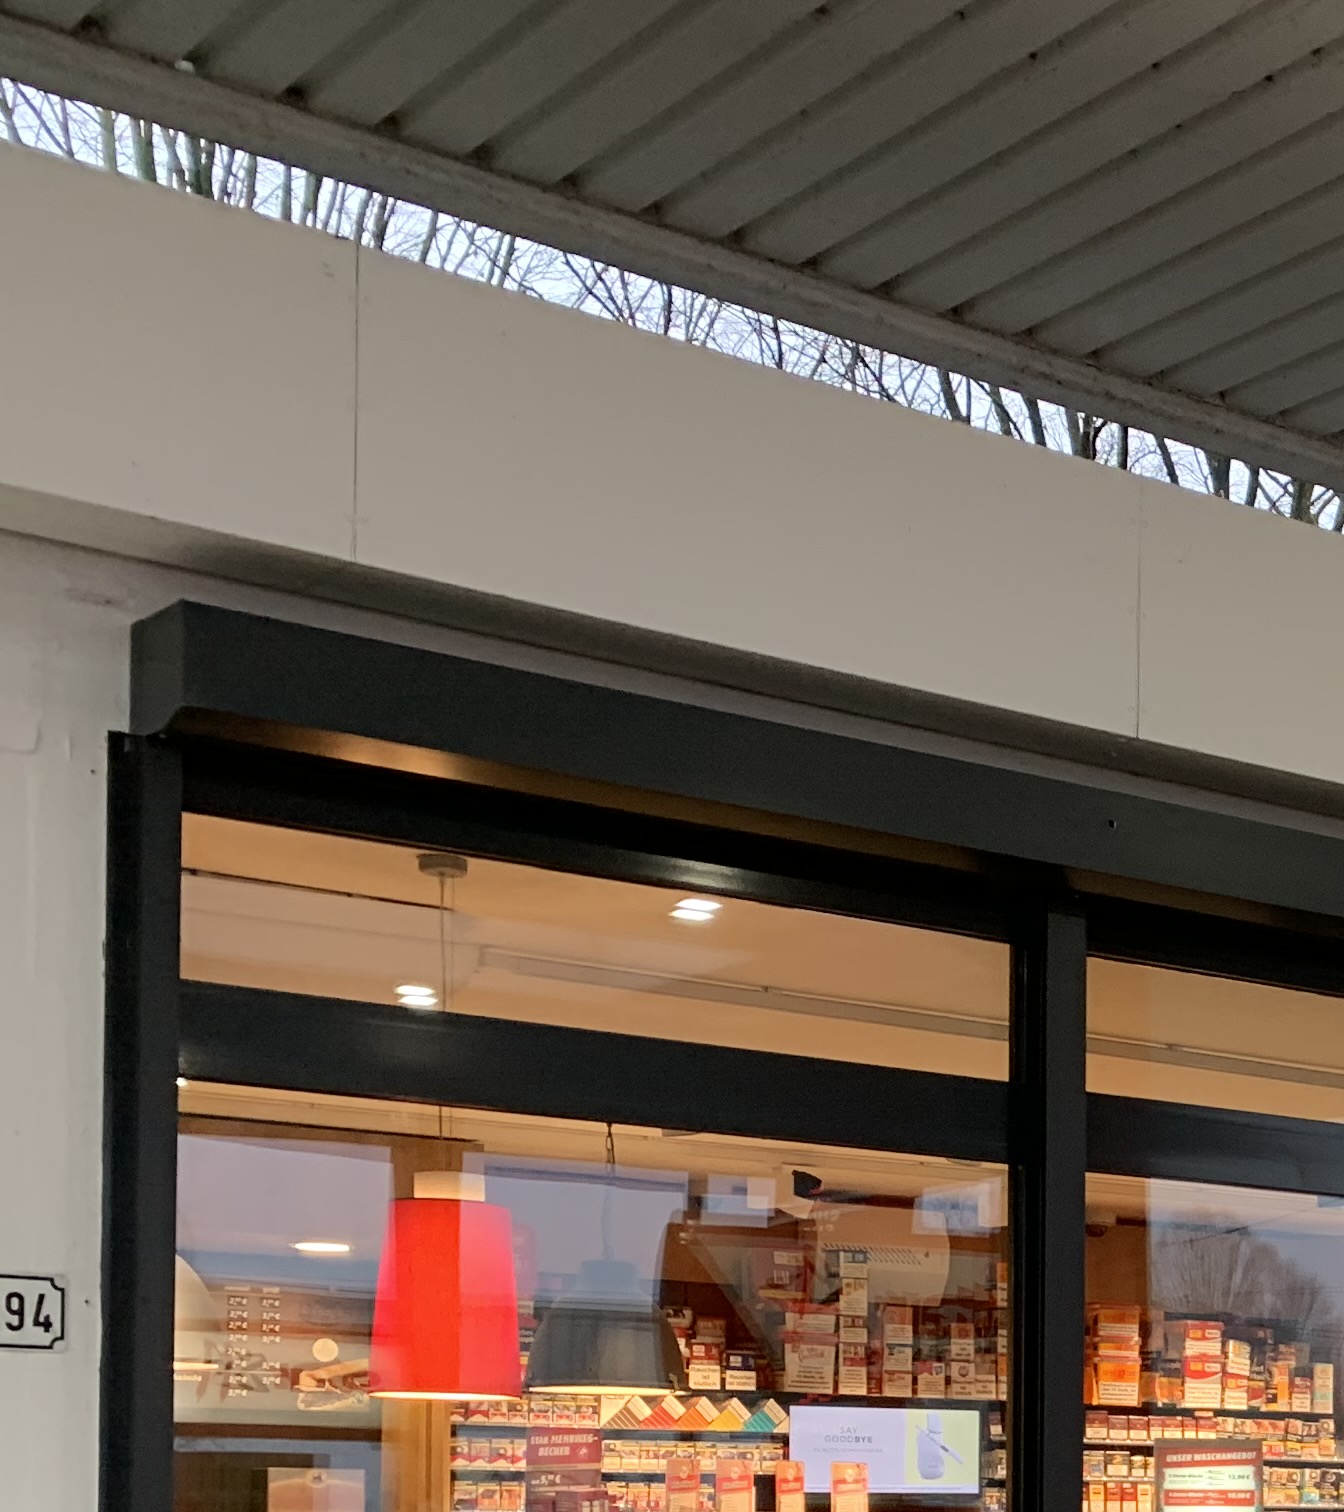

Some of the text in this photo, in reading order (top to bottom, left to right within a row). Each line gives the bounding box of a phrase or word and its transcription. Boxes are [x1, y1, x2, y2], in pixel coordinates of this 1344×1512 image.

[5, 1292, 53, 1333] 94
[839, 1426, 858, 1434] SAY
[824, 1435, 873, 1443] GOODBYE
[1166, 1451, 1257, 1462] UNSER WASCHANGEBOT
